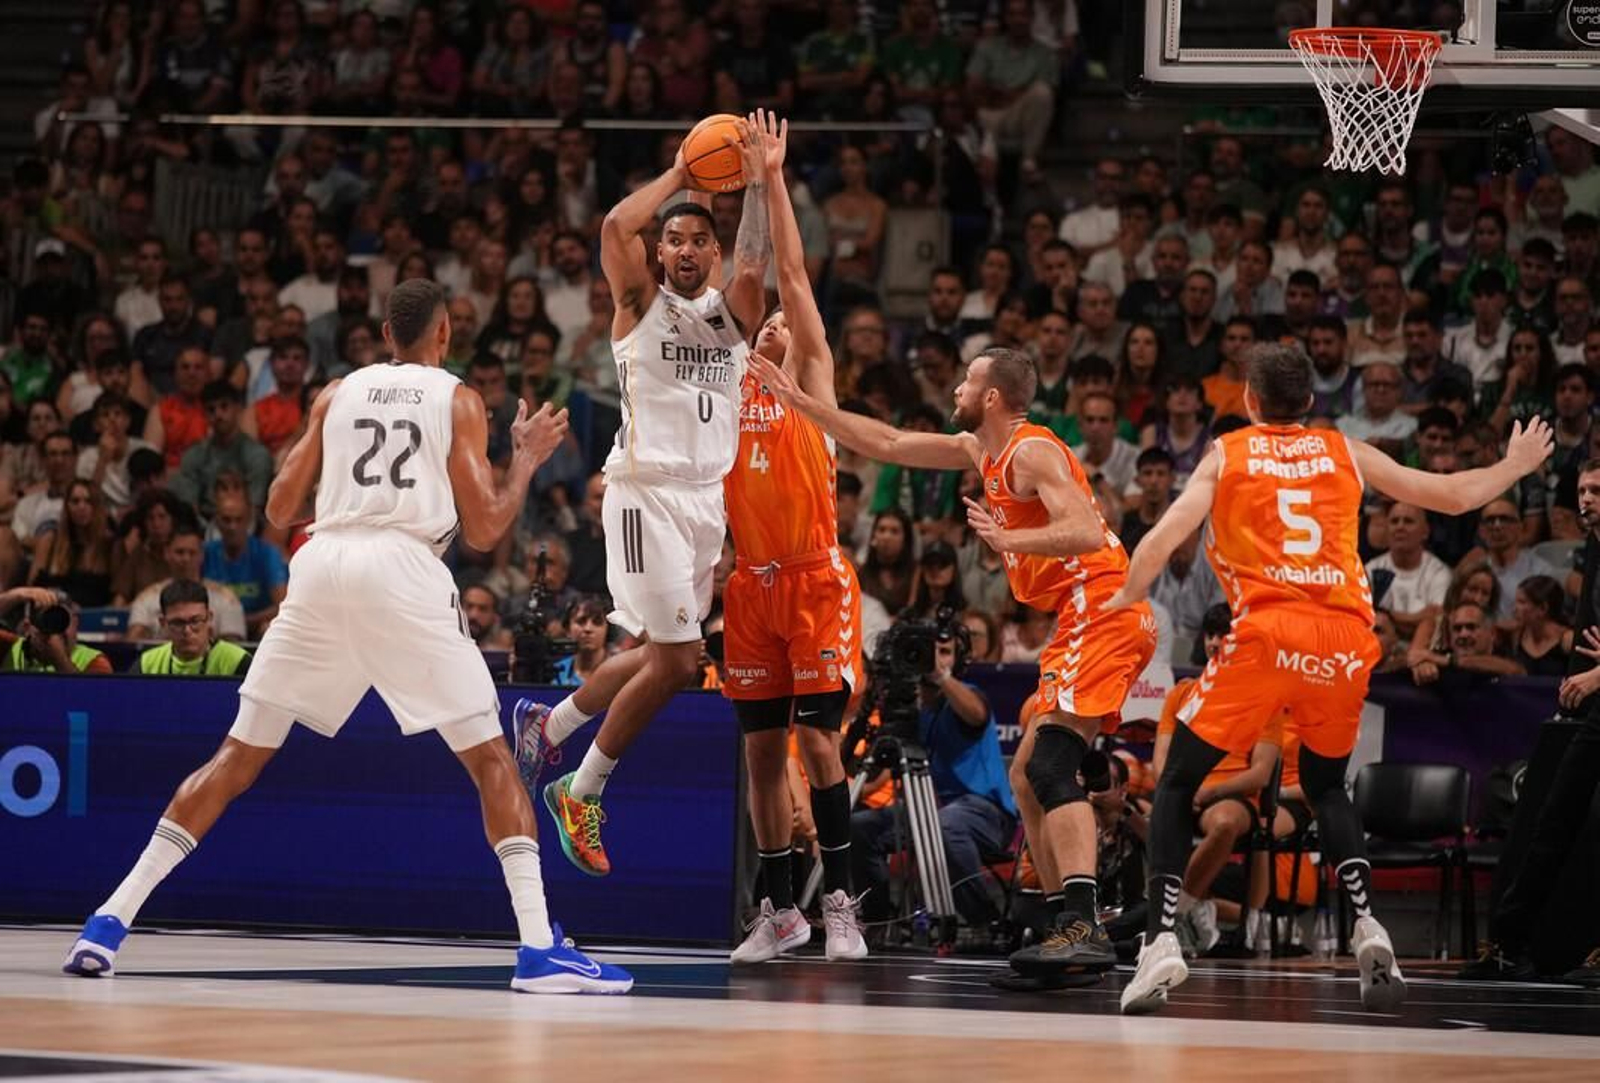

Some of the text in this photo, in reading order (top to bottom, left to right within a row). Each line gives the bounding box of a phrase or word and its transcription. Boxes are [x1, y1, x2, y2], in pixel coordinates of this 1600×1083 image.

[675, 364, 695, 380] FLY
[367, 387, 424, 405] TAVARES
[698, 391, 713, 423] 0
[353, 418, 422, 489] 22
[750, 442, 769, 474] 4
[1249, 436, 1269, 455] DE
[1277, 489, 1323, 555] 5
[1276, 648, 1336, 679] MGS
